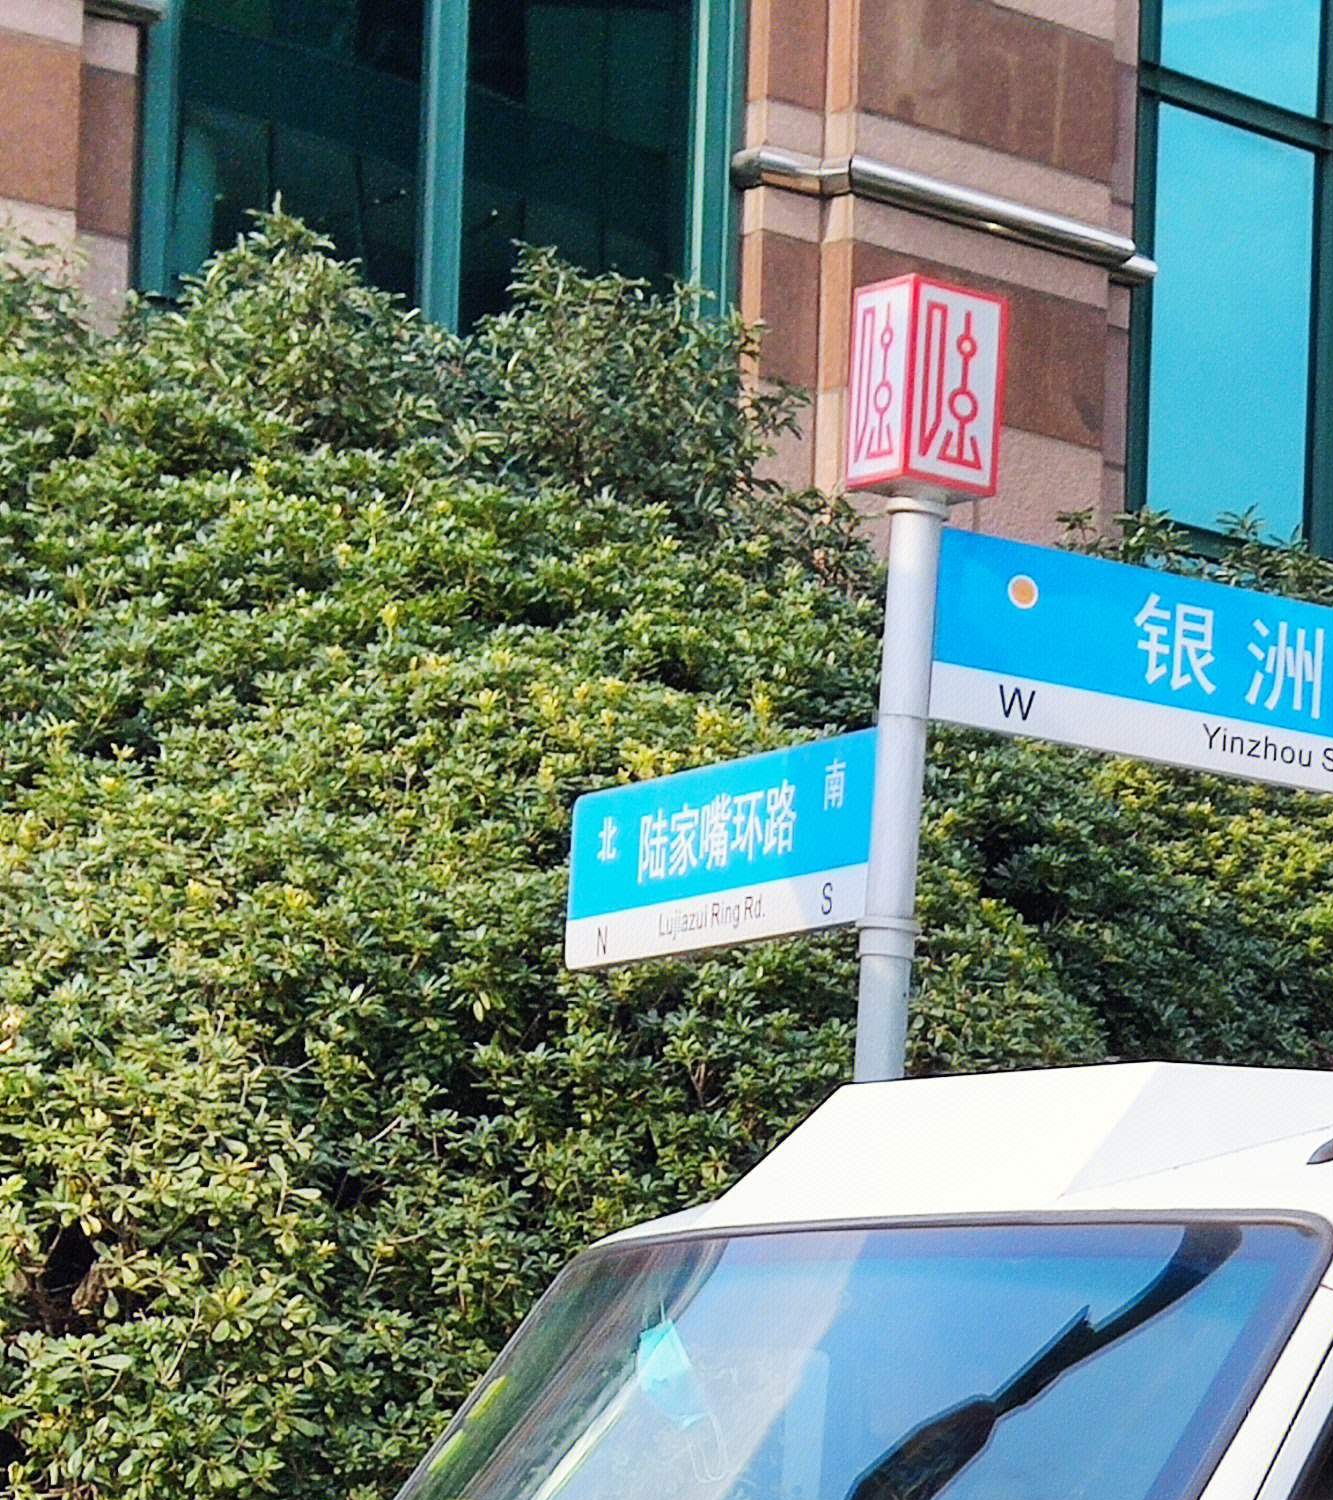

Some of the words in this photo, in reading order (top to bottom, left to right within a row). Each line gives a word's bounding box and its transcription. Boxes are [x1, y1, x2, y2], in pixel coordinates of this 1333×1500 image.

[999, 684, 1036, 721] W
[1202, 721, 1312, 769] Yinzhou
[824, 758, 847, 811] 南
[597, 817, 617, 861] 北
[637, 779, 796, 884] 陆家嘴环路
[659, 904, 708, 941] Lujiazui
[711, 900, 740, 929] Ring
[744, 893, 766, 921] Rd.
[821, 882, 833, 915] S
[597, 927, 608, 956] N
